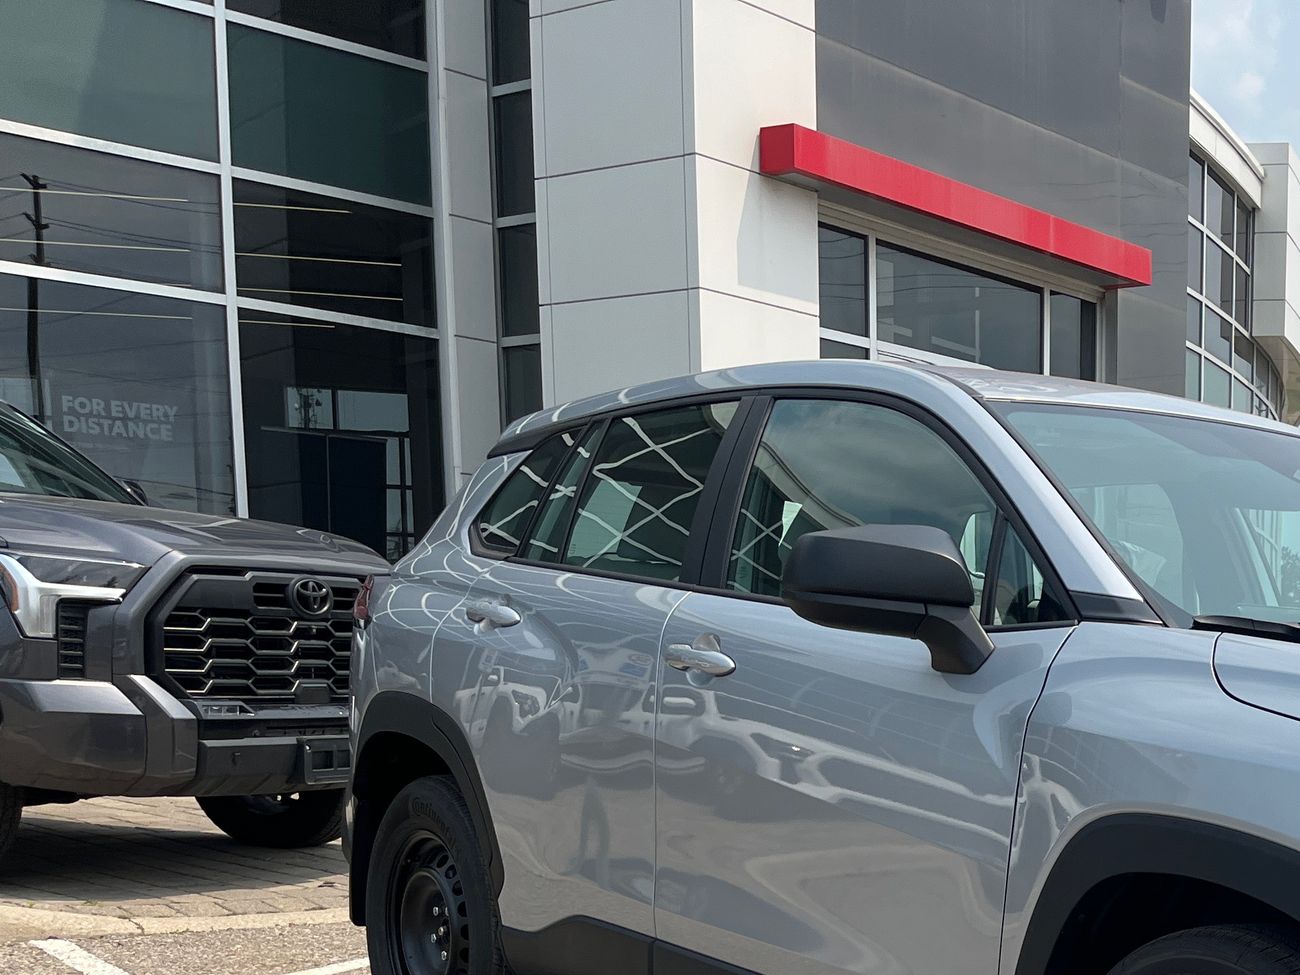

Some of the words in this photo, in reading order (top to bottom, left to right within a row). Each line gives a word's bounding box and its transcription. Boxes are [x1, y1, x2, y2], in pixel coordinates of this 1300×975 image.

[62, 395, 106, 416] FOR
[111, 400, 178, 423] EVERY
[63, 416, 173, 441] DISTANCE
